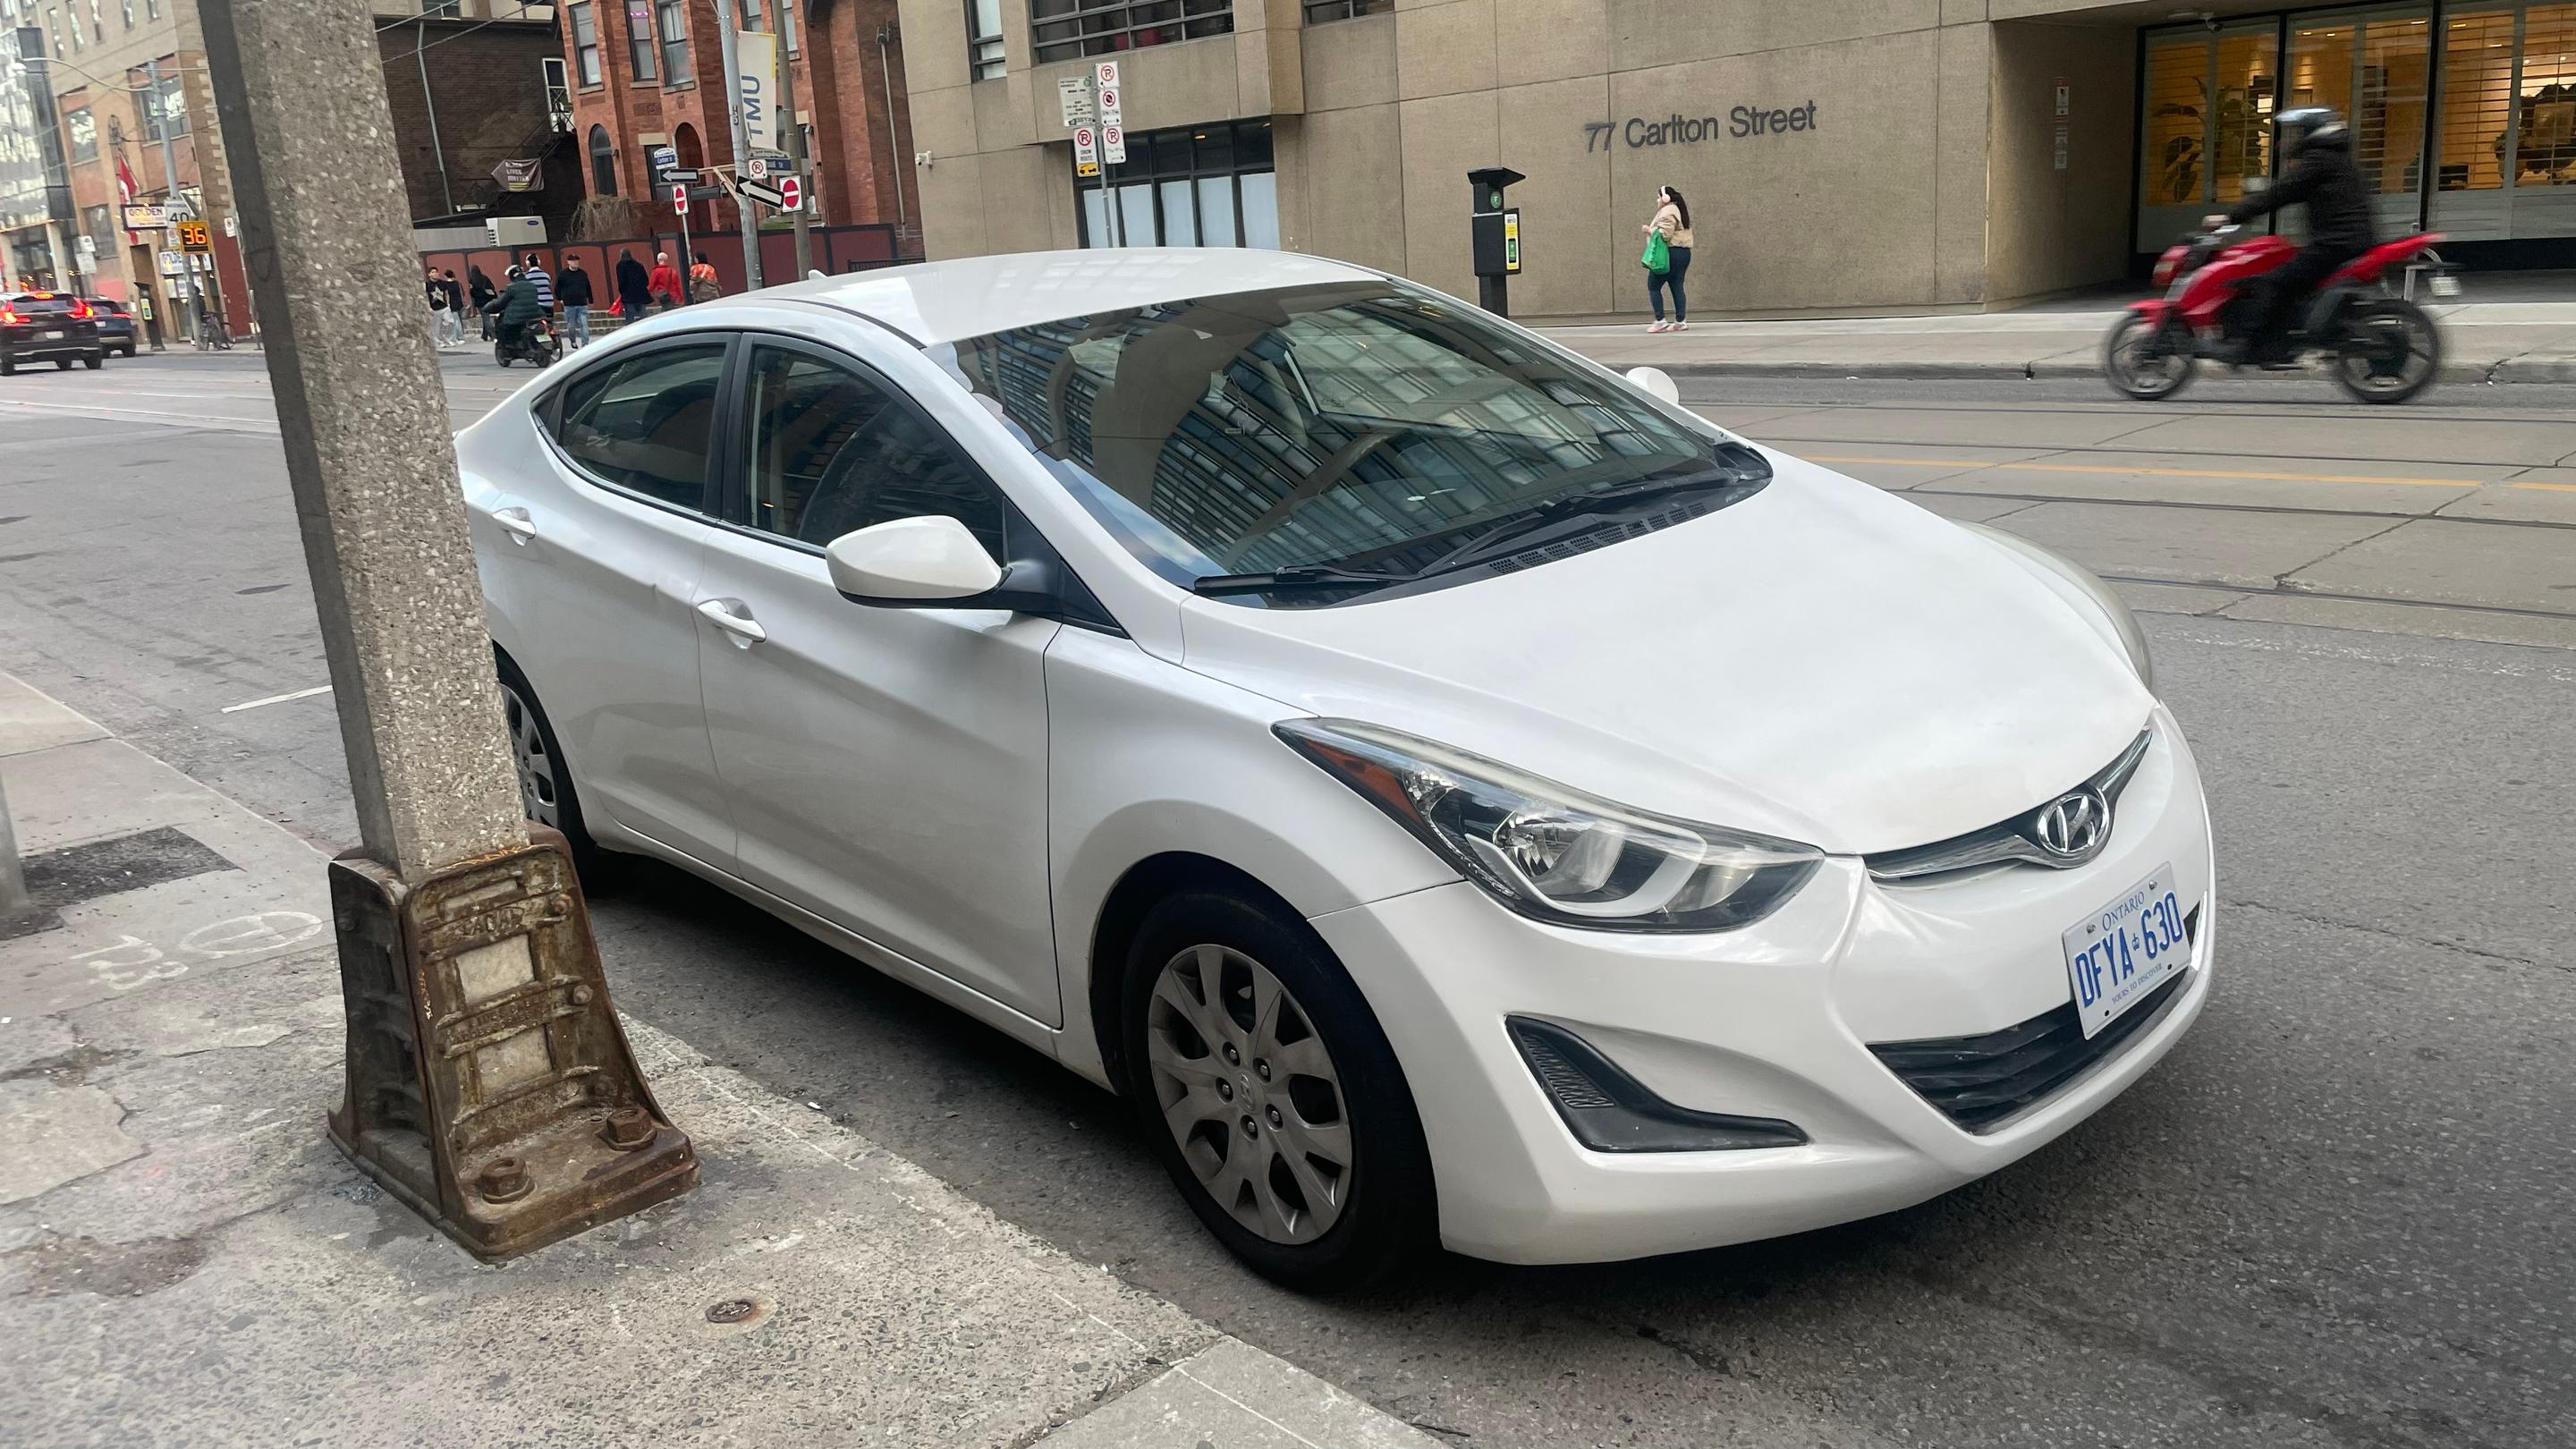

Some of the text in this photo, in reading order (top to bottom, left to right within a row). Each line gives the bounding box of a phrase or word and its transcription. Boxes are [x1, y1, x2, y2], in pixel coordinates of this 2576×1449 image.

[741, 75, 763, 140] TMU
[1585, 100, 1817, 153] 77 Carlton Street
[129, 207, 163, 216] GOLDEN
[170, 212, 190, 222] 40
[183, 228, 206, 245] 36
[2102, 891, 2145, 931] ONTARIO
[2075, 892, 2183, 1008] DFYA 630
